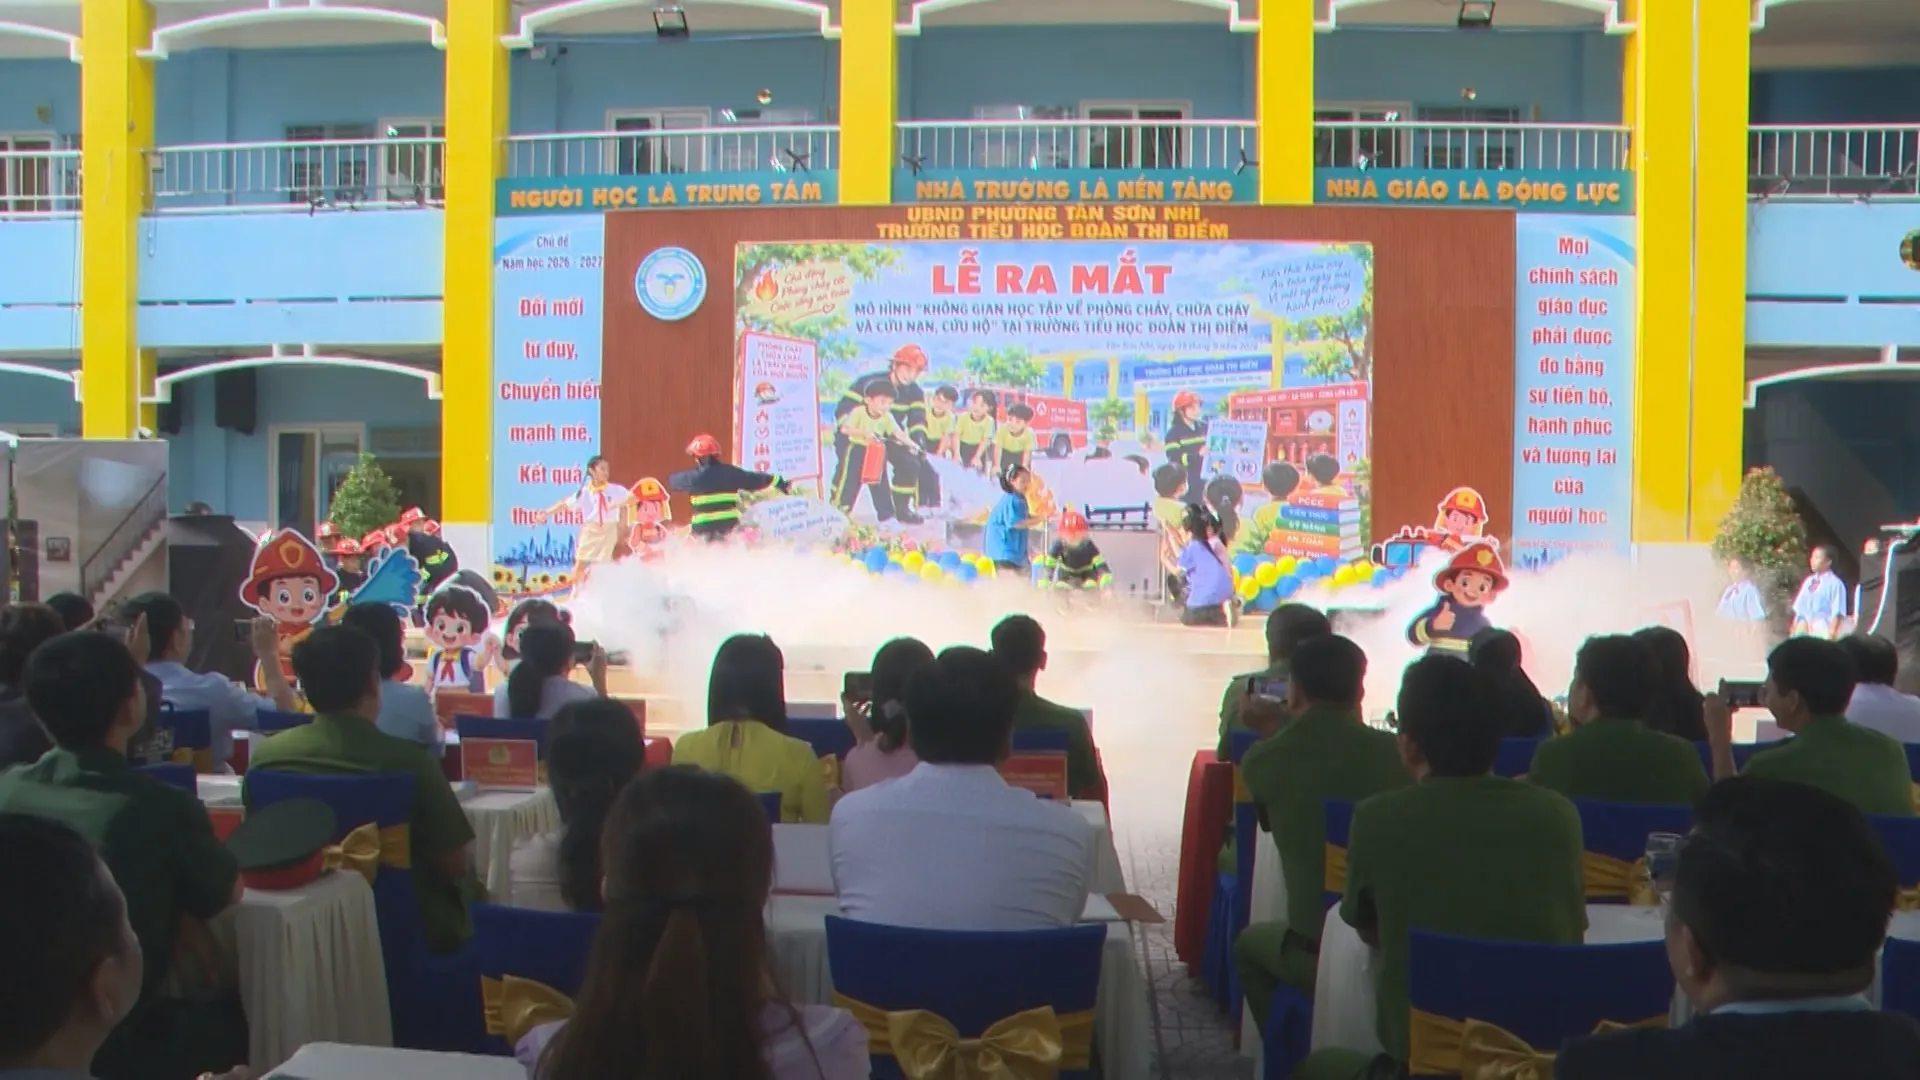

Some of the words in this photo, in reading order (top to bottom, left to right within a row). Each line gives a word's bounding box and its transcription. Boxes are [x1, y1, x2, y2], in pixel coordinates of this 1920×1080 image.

[511, 186, 583, 208] NGƯỜI
[592, 187, 638, 209] HỌC
[648, 181, 677, 205] LÀ
[686, 183, 761, 204] TRUNG
[770, 178, 822, 201] TÂM
[915, 176, 964, 199] NHÀ
[975, 177, 1069, 200] TRƯỜNG
[1080, 176, 1109, 199] LÀ
[1118, 176, 1164, 199] NỀN
[1172, 176, 1234, 200] TẢNG
[1326, 176, 1378, 199] NHÀ
[1387, 176, 1449, 200] GIÁO
[1459, 177, 1489, 201] LÀ
[1497, 177, 1567, 205] ĐỘNG
[1577, 181, 1620, 205] LỰC
[907, 206, 964, 222] UBND
[971, 202, 1057, 222] PHƯỜNG
[1066, 202, 1104, 221] TÂN
[1113, 204, 1155, 222] SƠN
[1164, 202, 1201, 221] NHÌ
[876, 219, 960, 239] TRƯỜNG
[971, 219, 1014, 239] TIỂU
[1021, 223, 1064, 241] HỌC
[1071, 220, 1129, 239] ĐOÀN
[1137, 223, 1169, 241] THỊ
[1174, 218, 1229, 239] ĐIỂM
[1558, 237, 1589, 259] Mọi
[502, 256, 524, 269] Năm
[527, 256, 544, 271] học
[547, 256, 570, 268] 2026
[580, 256, 602, 268] 2027
[933, 249, 982, 295] LỄ
[996, 264, 1058, 295] RA
[1071, 250, 1173, 295] MẮT
[1529, 268, 1574, 285] chính
[1579, 268, 1618, 286] sách
[520, 296, 547, 317] Đổi
[552, 297, 584, 317] mới
[854, 301, 875, 316] MÔ
[879, 300, 911, 316] HÌNH
[972, 302, 1003, 316] GIAN
[1007, 302, 1035, 317] HỌC
[1039, 301, 1063, 317] TẬP
[1067, 299, 1083, 315] VỀ
[1087, 301, 1133, 316] PHÒNG
[1136, 301, 1172, 317] CHÁY,
[1176, 301, 1212, 316] CHỮA
[1216, 301, 1250, 316] CHÁY
[1538, 297, 1573, 316] giáo
[1579, 297, 1608, 319] dục
[856, 319, 872, 335] VÀ
[877, 319, 902, 334] CỨU
[907, 321, 938, 336] NẠN,
[942, 319, 968, 334] CỨU
[1002, 321, 1021, 336] TẠI
[1027, 317, 1080, 334] TRƯỜNG
[1084, 318, 1112, 334] TIỂU
[1116, 320, 1143, 336] HỌC
[1148, 318, 1185, 334] ĐOÀN
[1191, 320, 1211, 336] THỊ
[1215, 318, 1249, 334] ĐIỂM
[1532, 325, 1567, 345] phải
[1573, 327, 1613, 349] được
[524, 341, 541, 359] tư
[545, 341, 578, 361] duy,
[1539, 357, 1559, 374] đo
[1564, 354, 1604, 377] bằng
[501, 378, 561, 401] Chuyển
[1529, 388, 1547, 408] sự
[1553, 385, 1583, 405] tiến
[1588, 388, 1613, 409] bộ,
[510, 424, 556, 446] mạnh
[561, 423, 593, 443] mẽ,
[1528, 416, 1567, 437] hạnh
[1573, 417, 1612, 436] phúc
[1522, 447, 1541, 464] và
[1546, 448, 1591, 466] tương
[1597, 449, 1617, 464] lai
[520, 461, 547, 484] Kết
[1554, 476, 1584, 494] của
[1528, 507, 1572, 525] người
